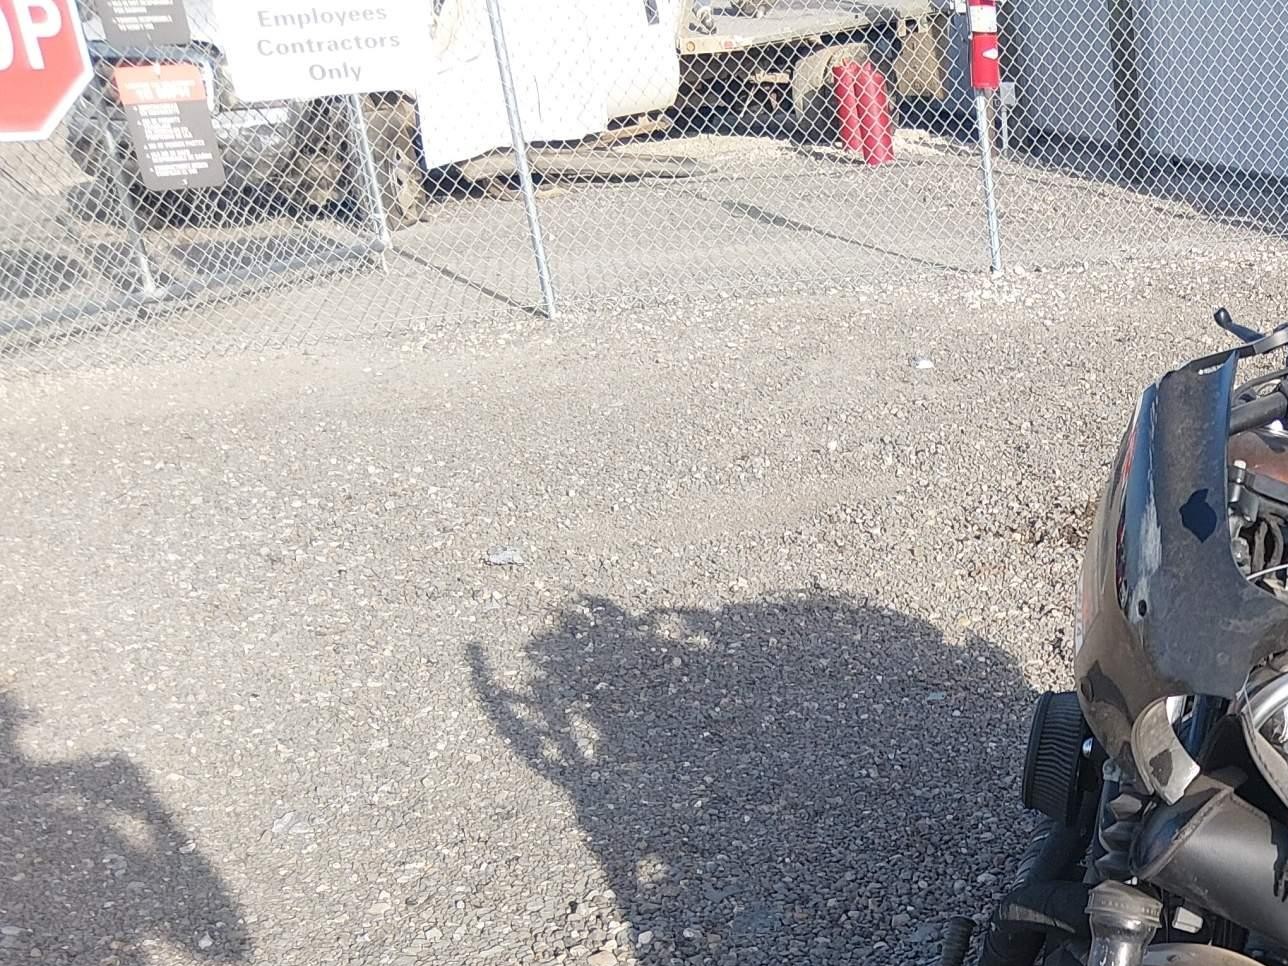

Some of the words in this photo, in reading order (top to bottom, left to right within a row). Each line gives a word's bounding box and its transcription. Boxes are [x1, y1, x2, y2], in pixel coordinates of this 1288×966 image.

[256, 7, 388, 29] Employees
[256, 34, 401, 57] Contractors
[308, 61, 362, 82] Only
